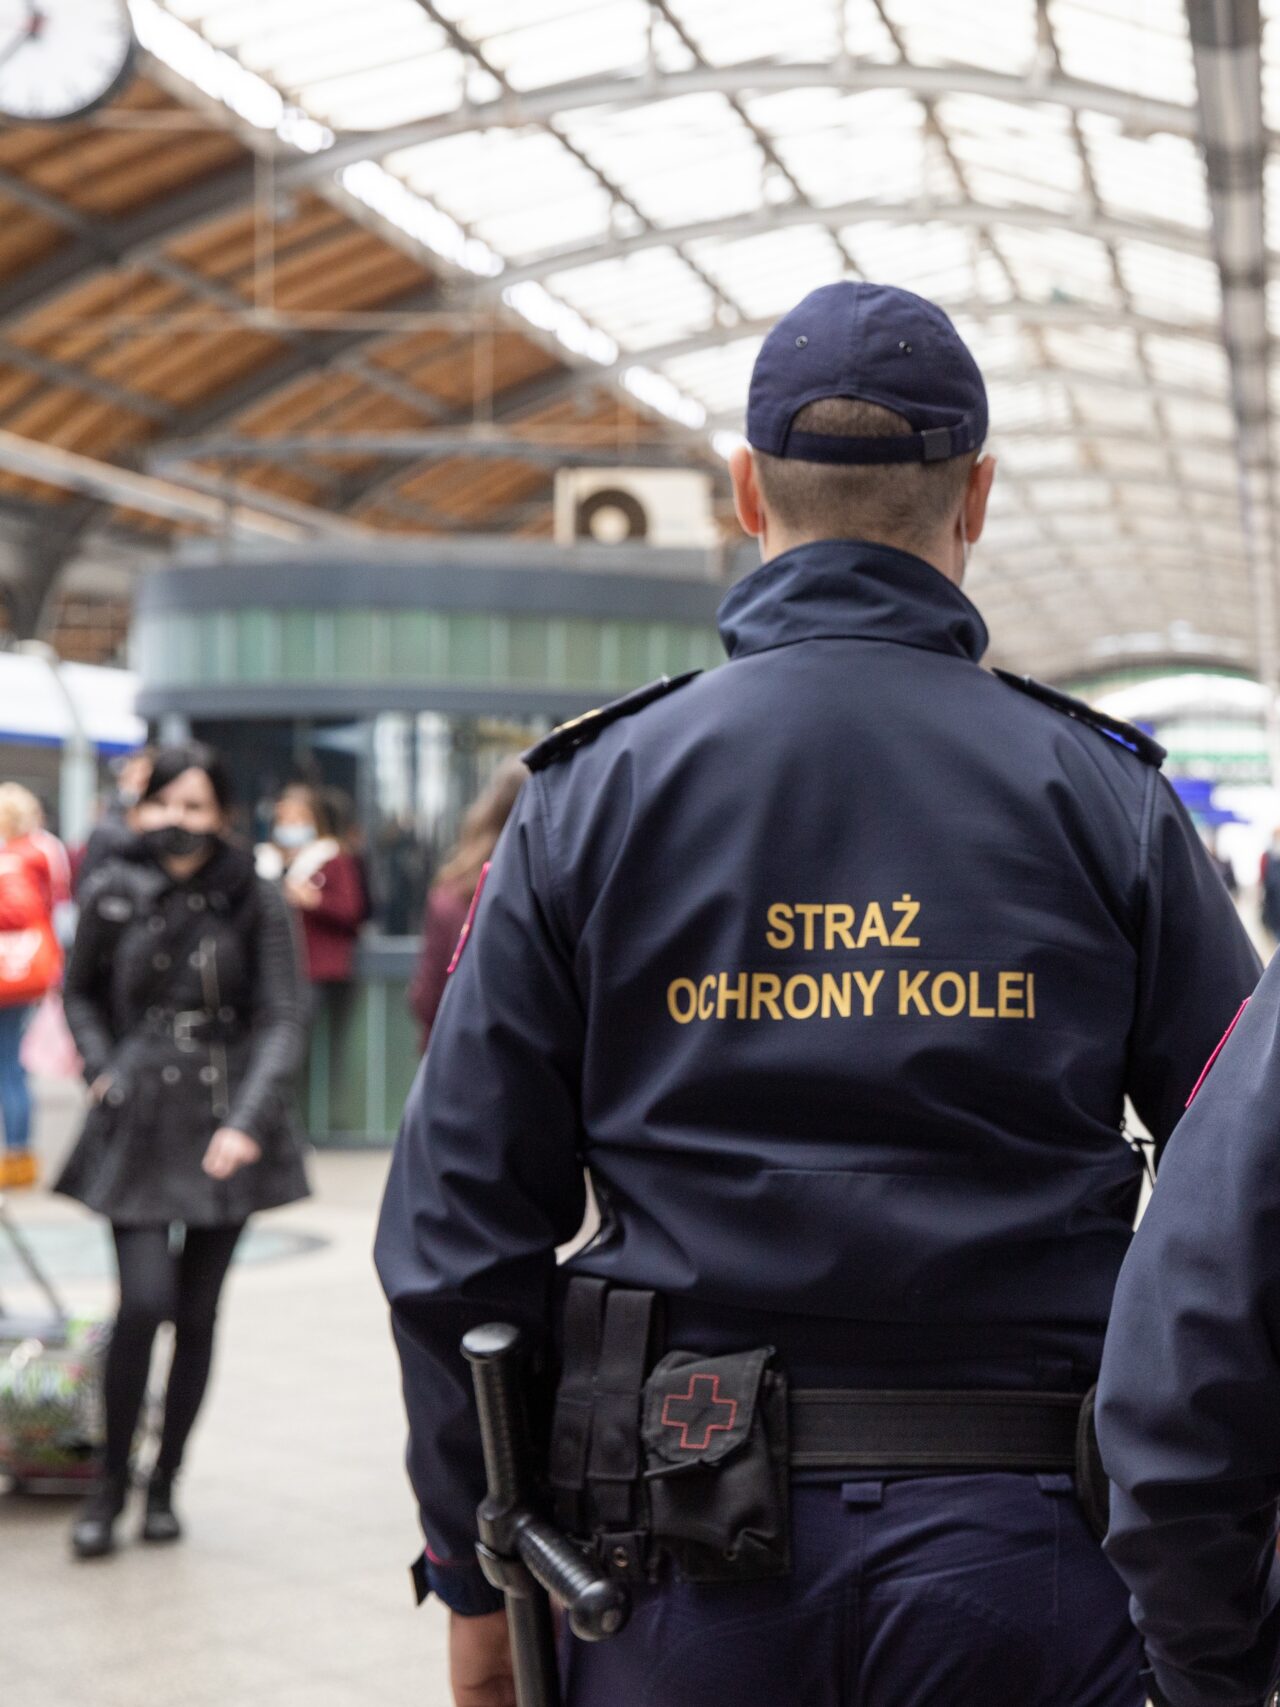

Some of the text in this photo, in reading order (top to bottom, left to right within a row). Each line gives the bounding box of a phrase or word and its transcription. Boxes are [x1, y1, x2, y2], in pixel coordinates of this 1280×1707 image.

[766, 893, 921, 950] STRAŻ
[667, 970, 1036, 1024] OCHRONY KOLEI
